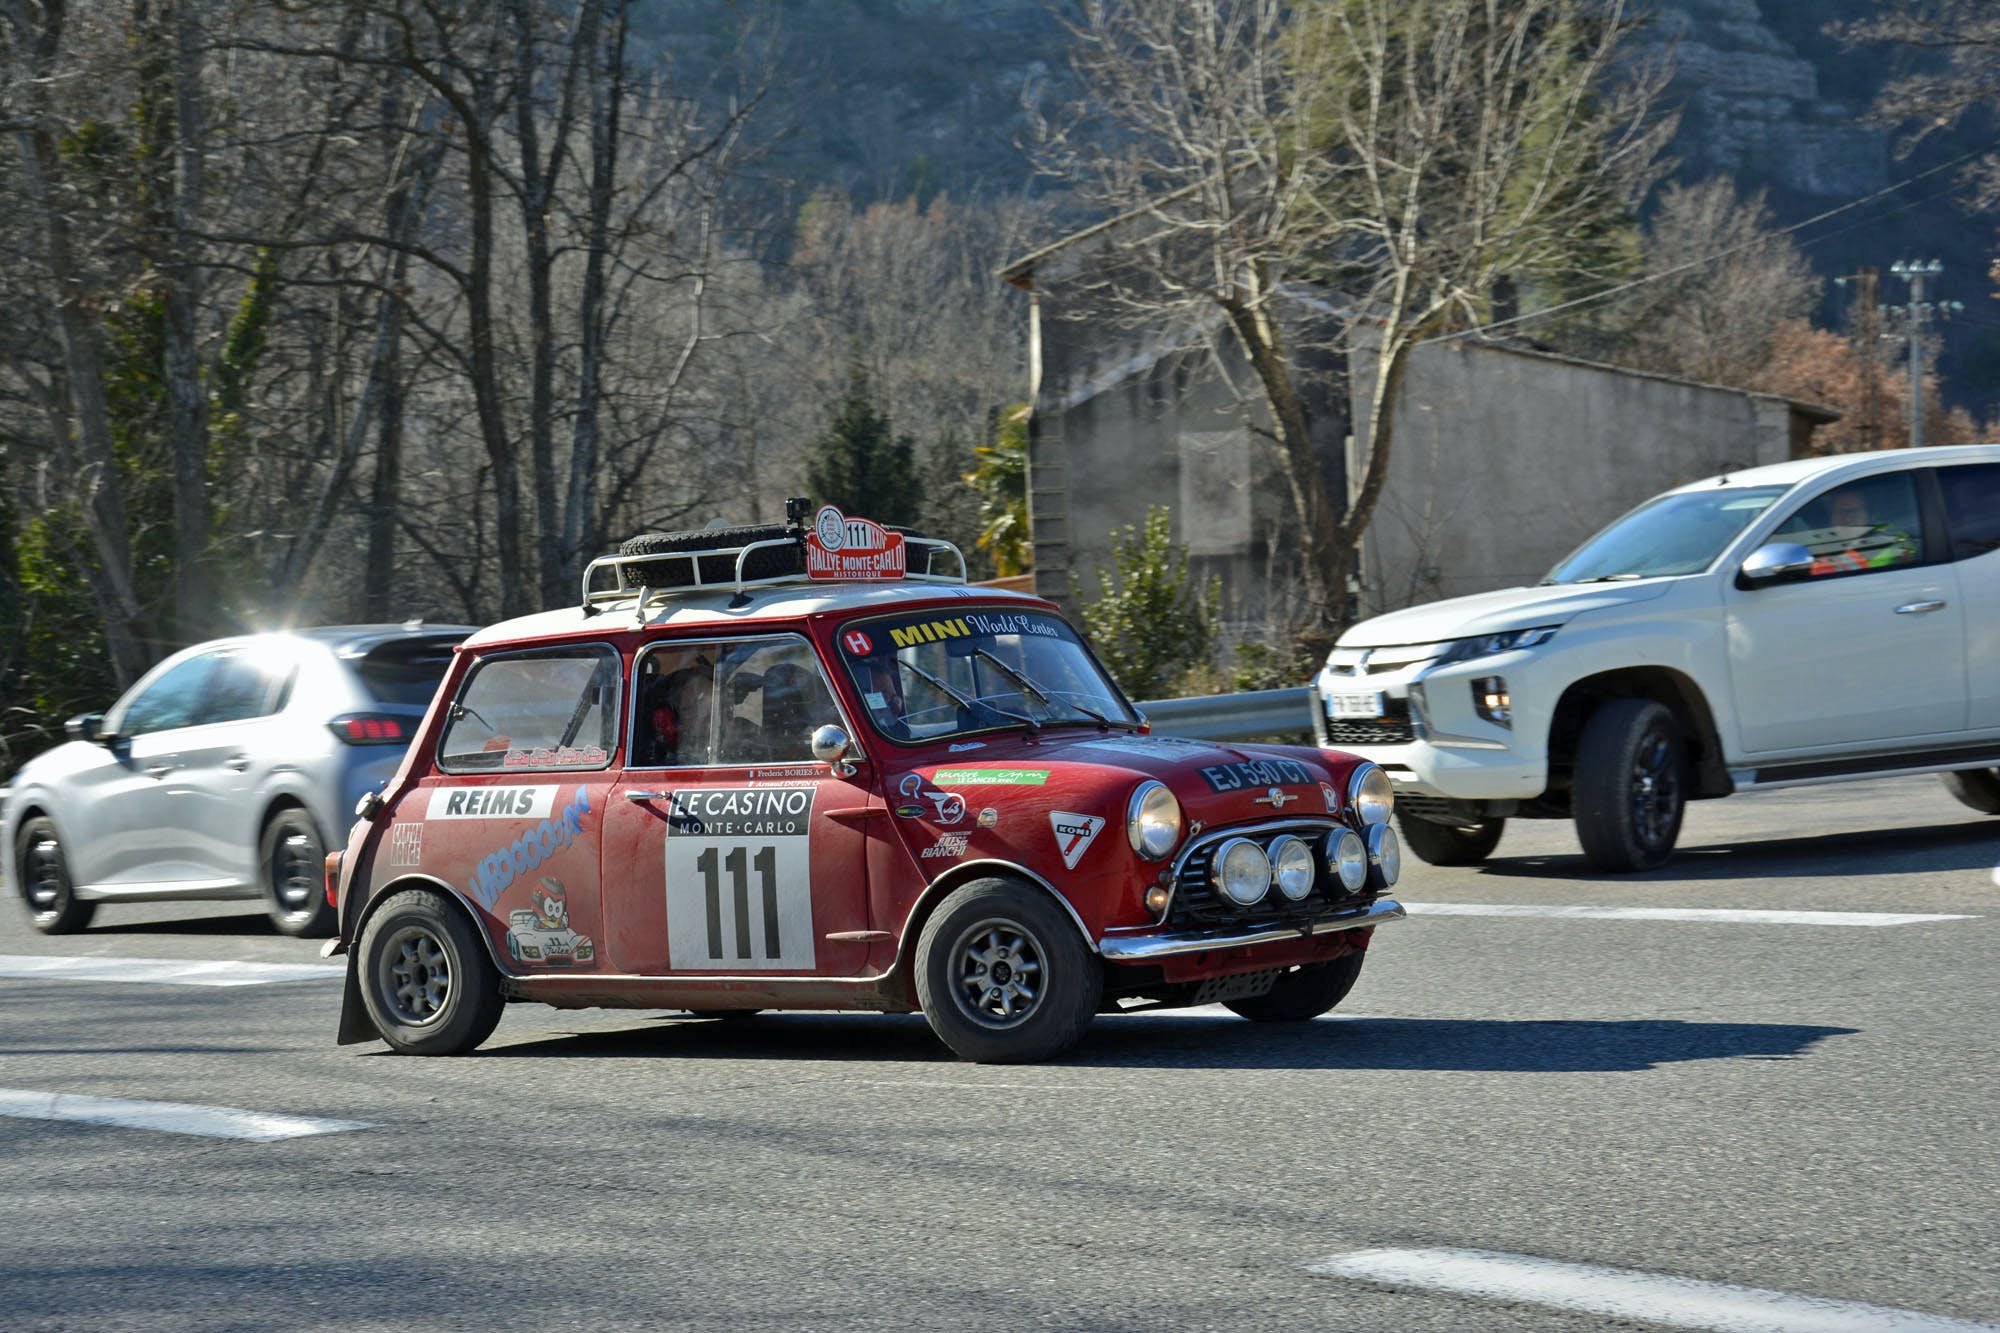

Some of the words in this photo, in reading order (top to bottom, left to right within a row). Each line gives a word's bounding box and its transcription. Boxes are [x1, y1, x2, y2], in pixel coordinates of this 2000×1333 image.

[848, 524, 867, 546] 111
[810, 547, 841, 571] RALLYE
[846, 632, 870, 653] H
[889, 618, 971, 648] MINI
[965, 615, 1019, 633] World
[1014, 615, 1058, 637] Center
[1201, 764, 1241, 791] EJ
[1277, 761, 1309, 783] CT
[445, 789, 536, 815] REIMS
[675, 793, 702, 816] LE
[705, 792, 807, 816] CASINO
[934, 837, 962, 847] JULES
[1058, 826, 1090, 836] KONI
[921, 845, 967, 858] BIANCHI
[697, 846, 781, 959] 111
